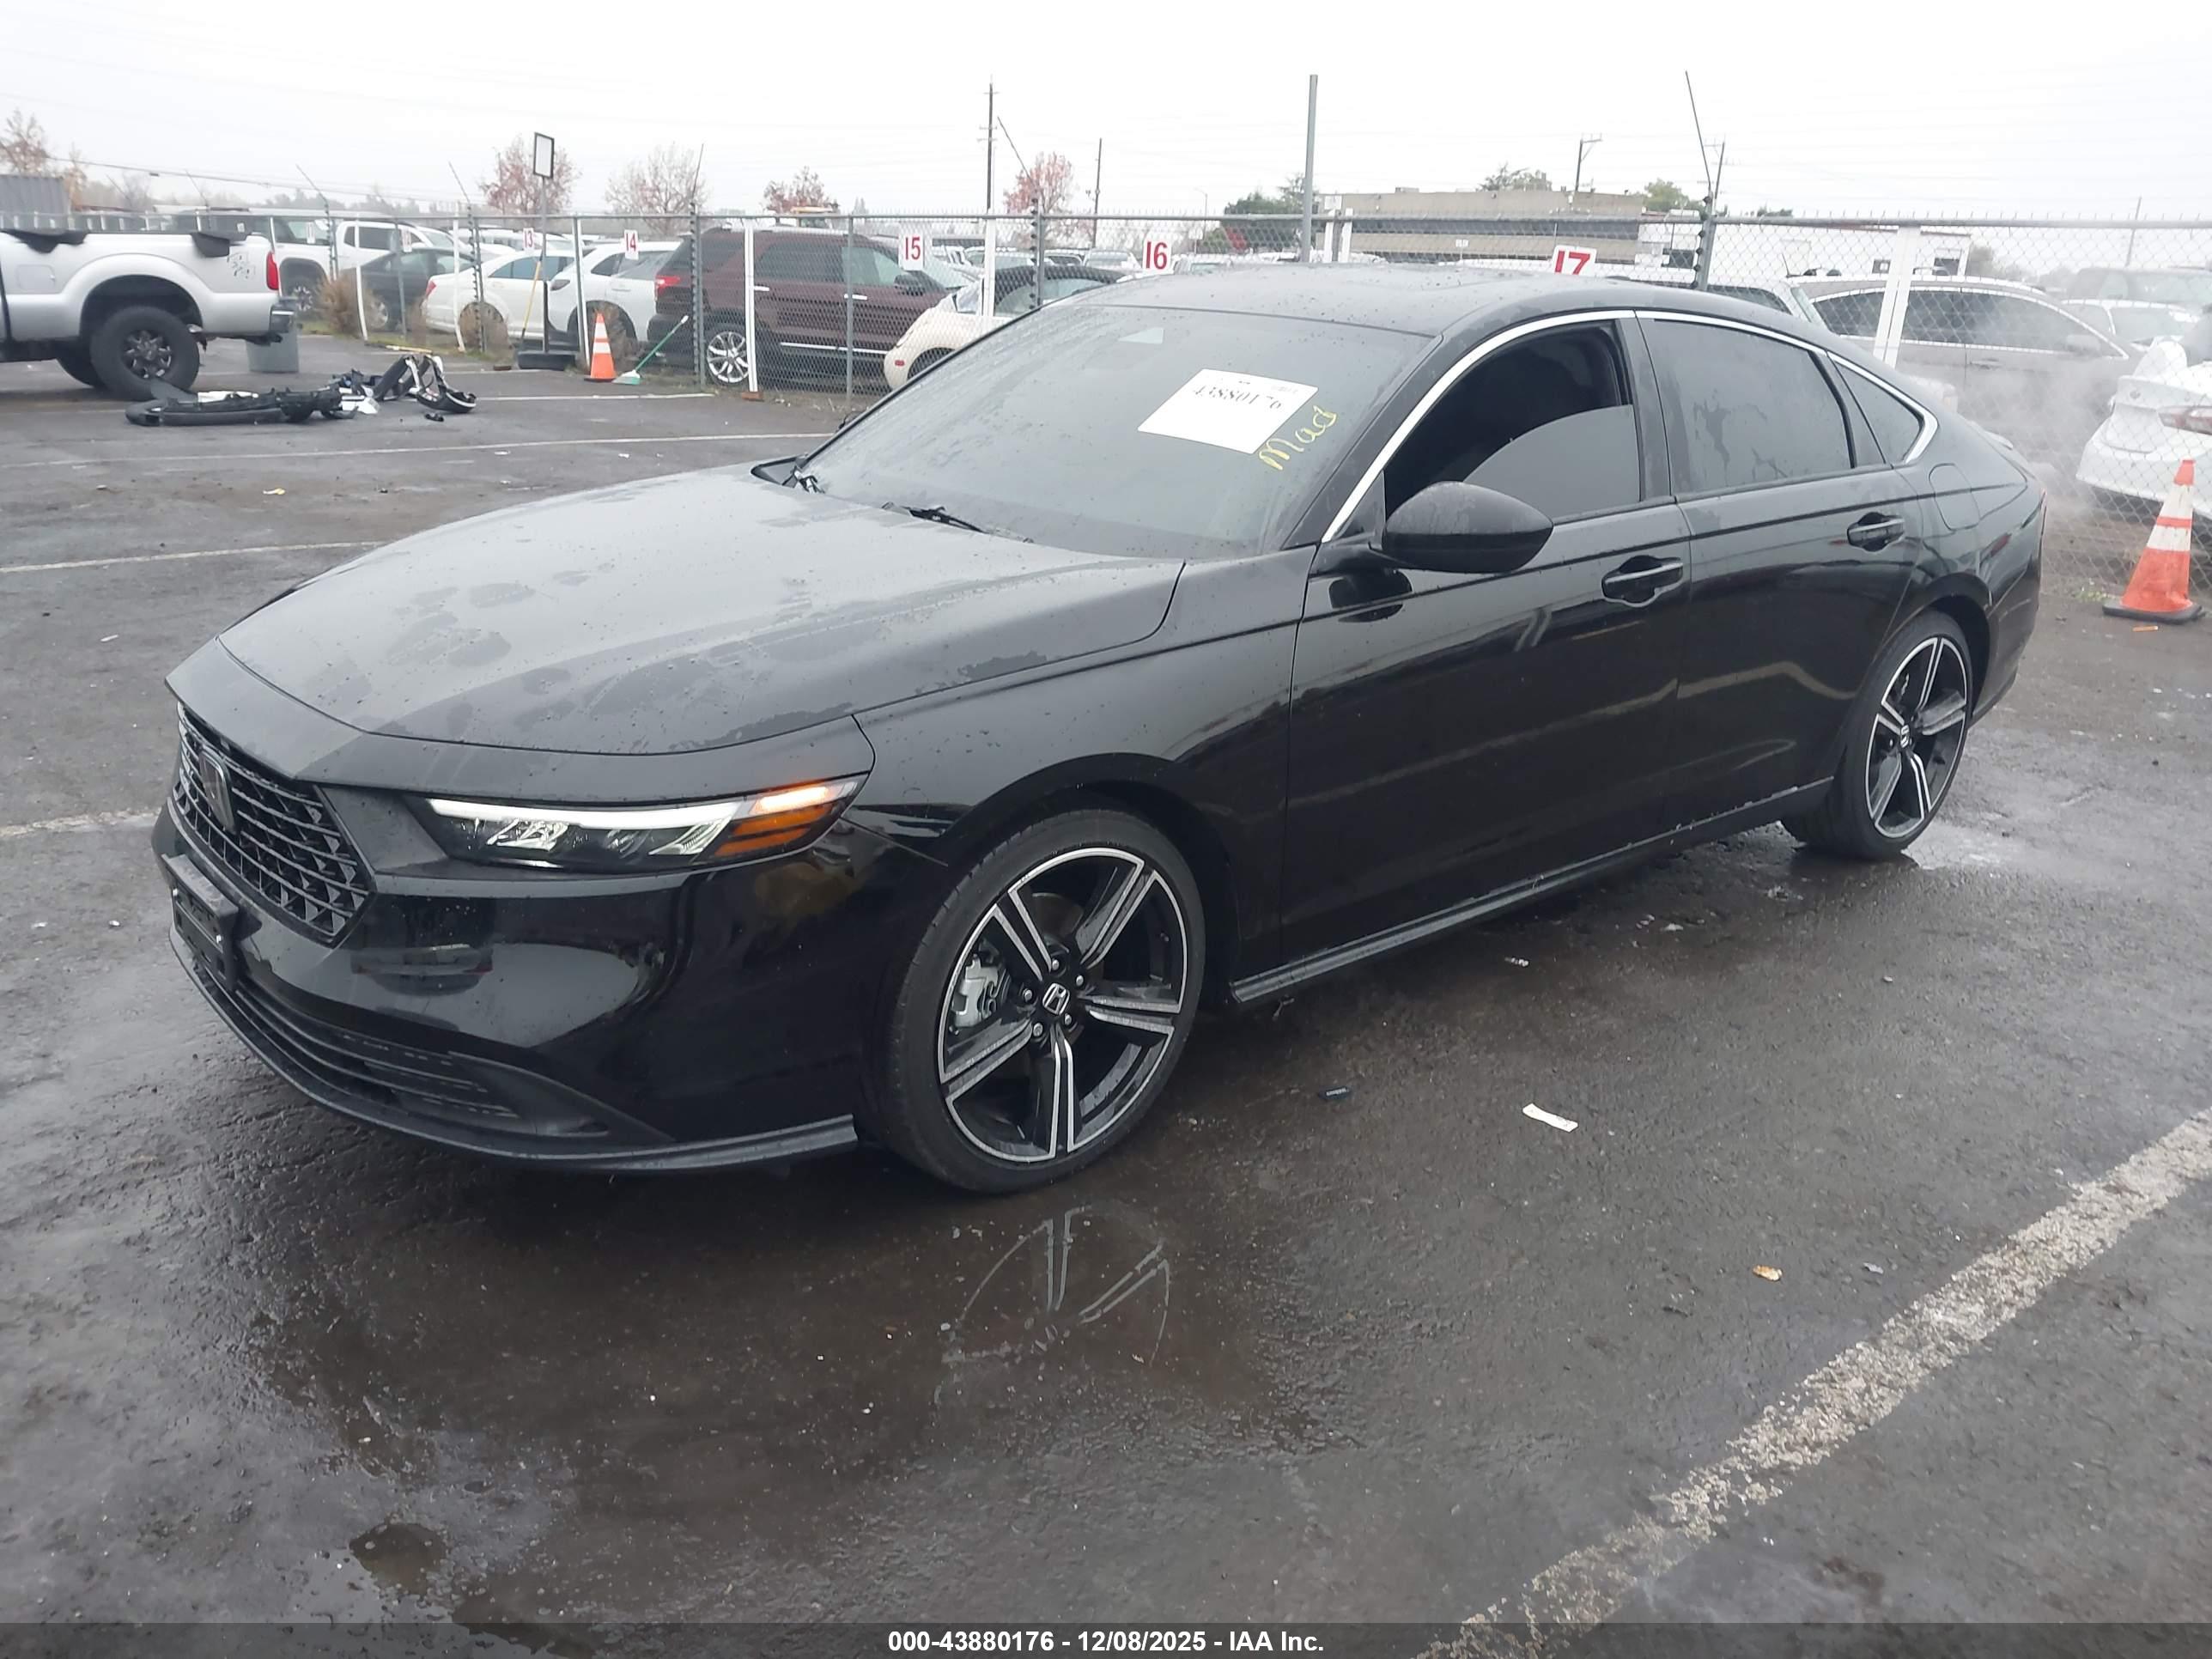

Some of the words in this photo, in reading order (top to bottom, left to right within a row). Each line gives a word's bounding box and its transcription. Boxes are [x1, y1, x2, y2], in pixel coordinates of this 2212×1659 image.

[524, 230, 533, 248] 13
[625, 233, 637, 252] 14
[905, 236, 921, 260] 15
[1146, 241, 1168, 270] 16
[1554, 250, 1591, 276] 17
[1259, 405, 1338, 470] Mad
